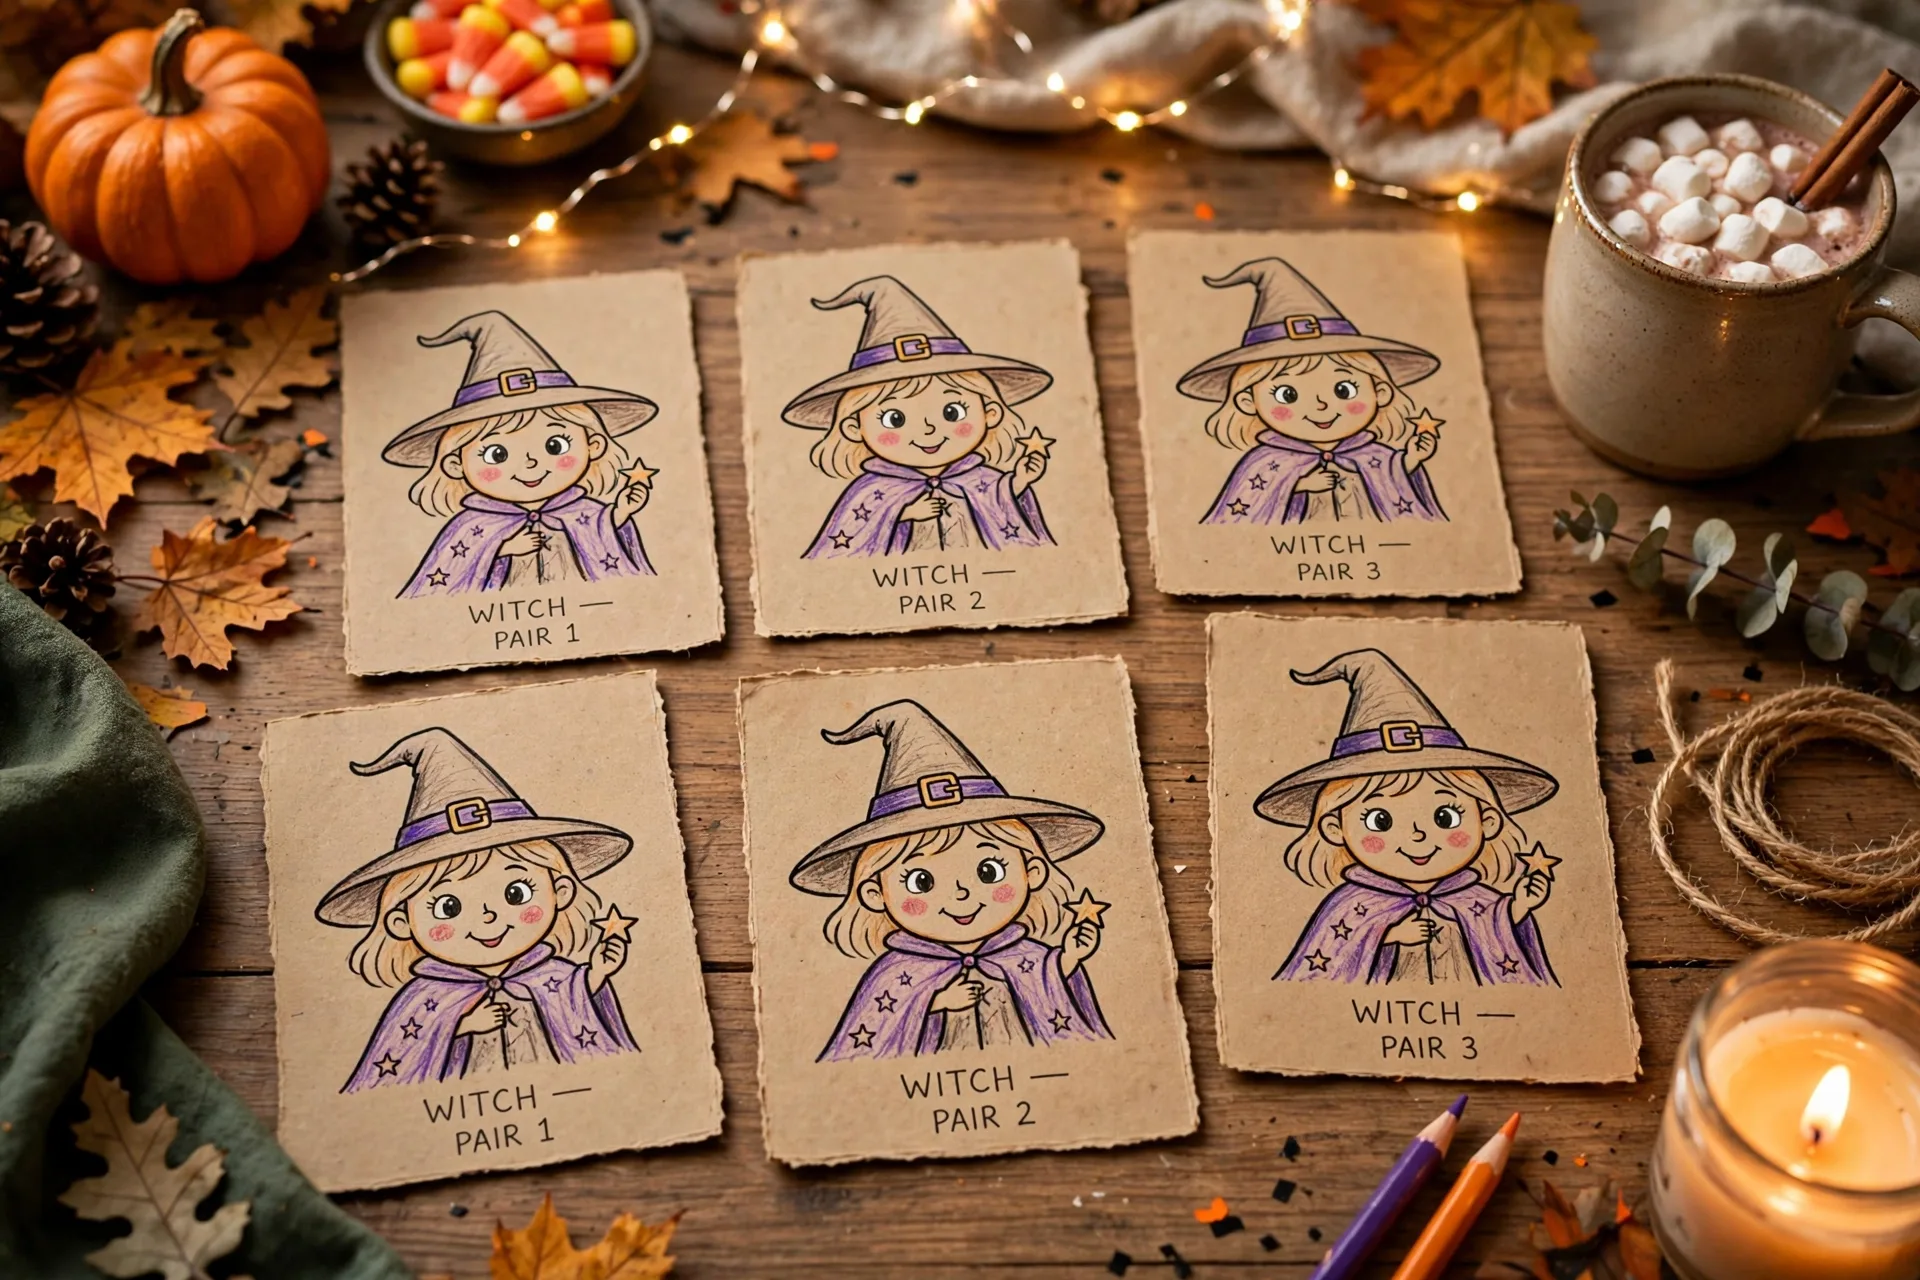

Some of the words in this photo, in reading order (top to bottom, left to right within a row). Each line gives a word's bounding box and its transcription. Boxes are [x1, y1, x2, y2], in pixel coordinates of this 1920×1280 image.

[1270, 534, 1366, 555] WITCH
[872, 563, 969, 588] WITCH
[1297, 562, 1354, 582] PAIR
[1366, 561, 1381, 581] 3
[468, 596, 566, 625] WITCH
[899, 593, 957, 615] PAIR
[969, 590, 986, 610] 2
[494, 627, 553, 651] PAIR
[566, 622, 581, 643] 1
[1351, 998, 1461, 1027] WITCH
[1381, 1035, 1447, 1060] PAIR
[1461, 1035, 1478, 1061] 3
[899, 1064, 1014, 1100] WITCH
[422, 1083, 537, 1124] WITCH
[932, 1104, 1001, 1135] PAIR
[1016, 1100, 1037, 1127] 2
[455, 1123, 523, 1156] PAIR
[537, 1117, 555, 1143] 1
